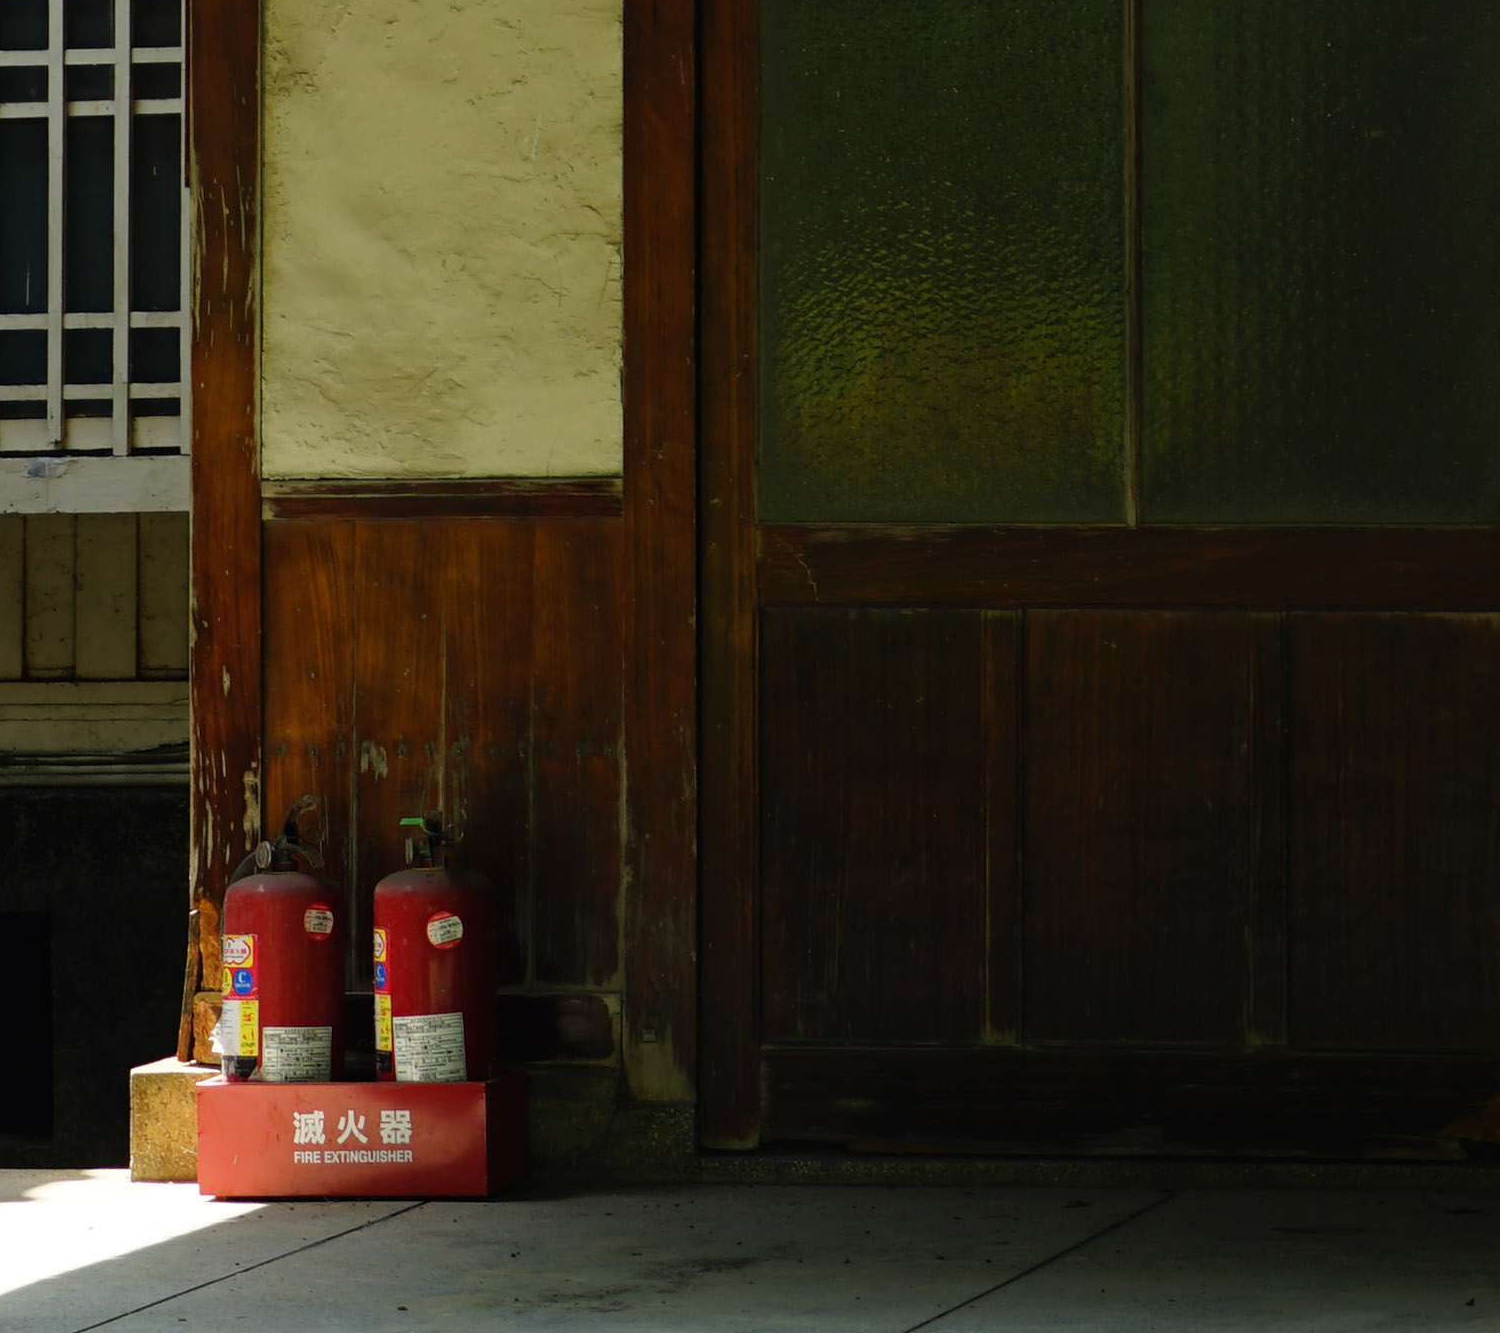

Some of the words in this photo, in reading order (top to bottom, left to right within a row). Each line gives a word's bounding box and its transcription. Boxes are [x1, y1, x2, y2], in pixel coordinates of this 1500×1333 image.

[293, 1110, 413, 1144] 滅火器
[294, 1150, 321, 1164] FIRE
[324, 1150, 413, 1163] EXTINGUISHER
